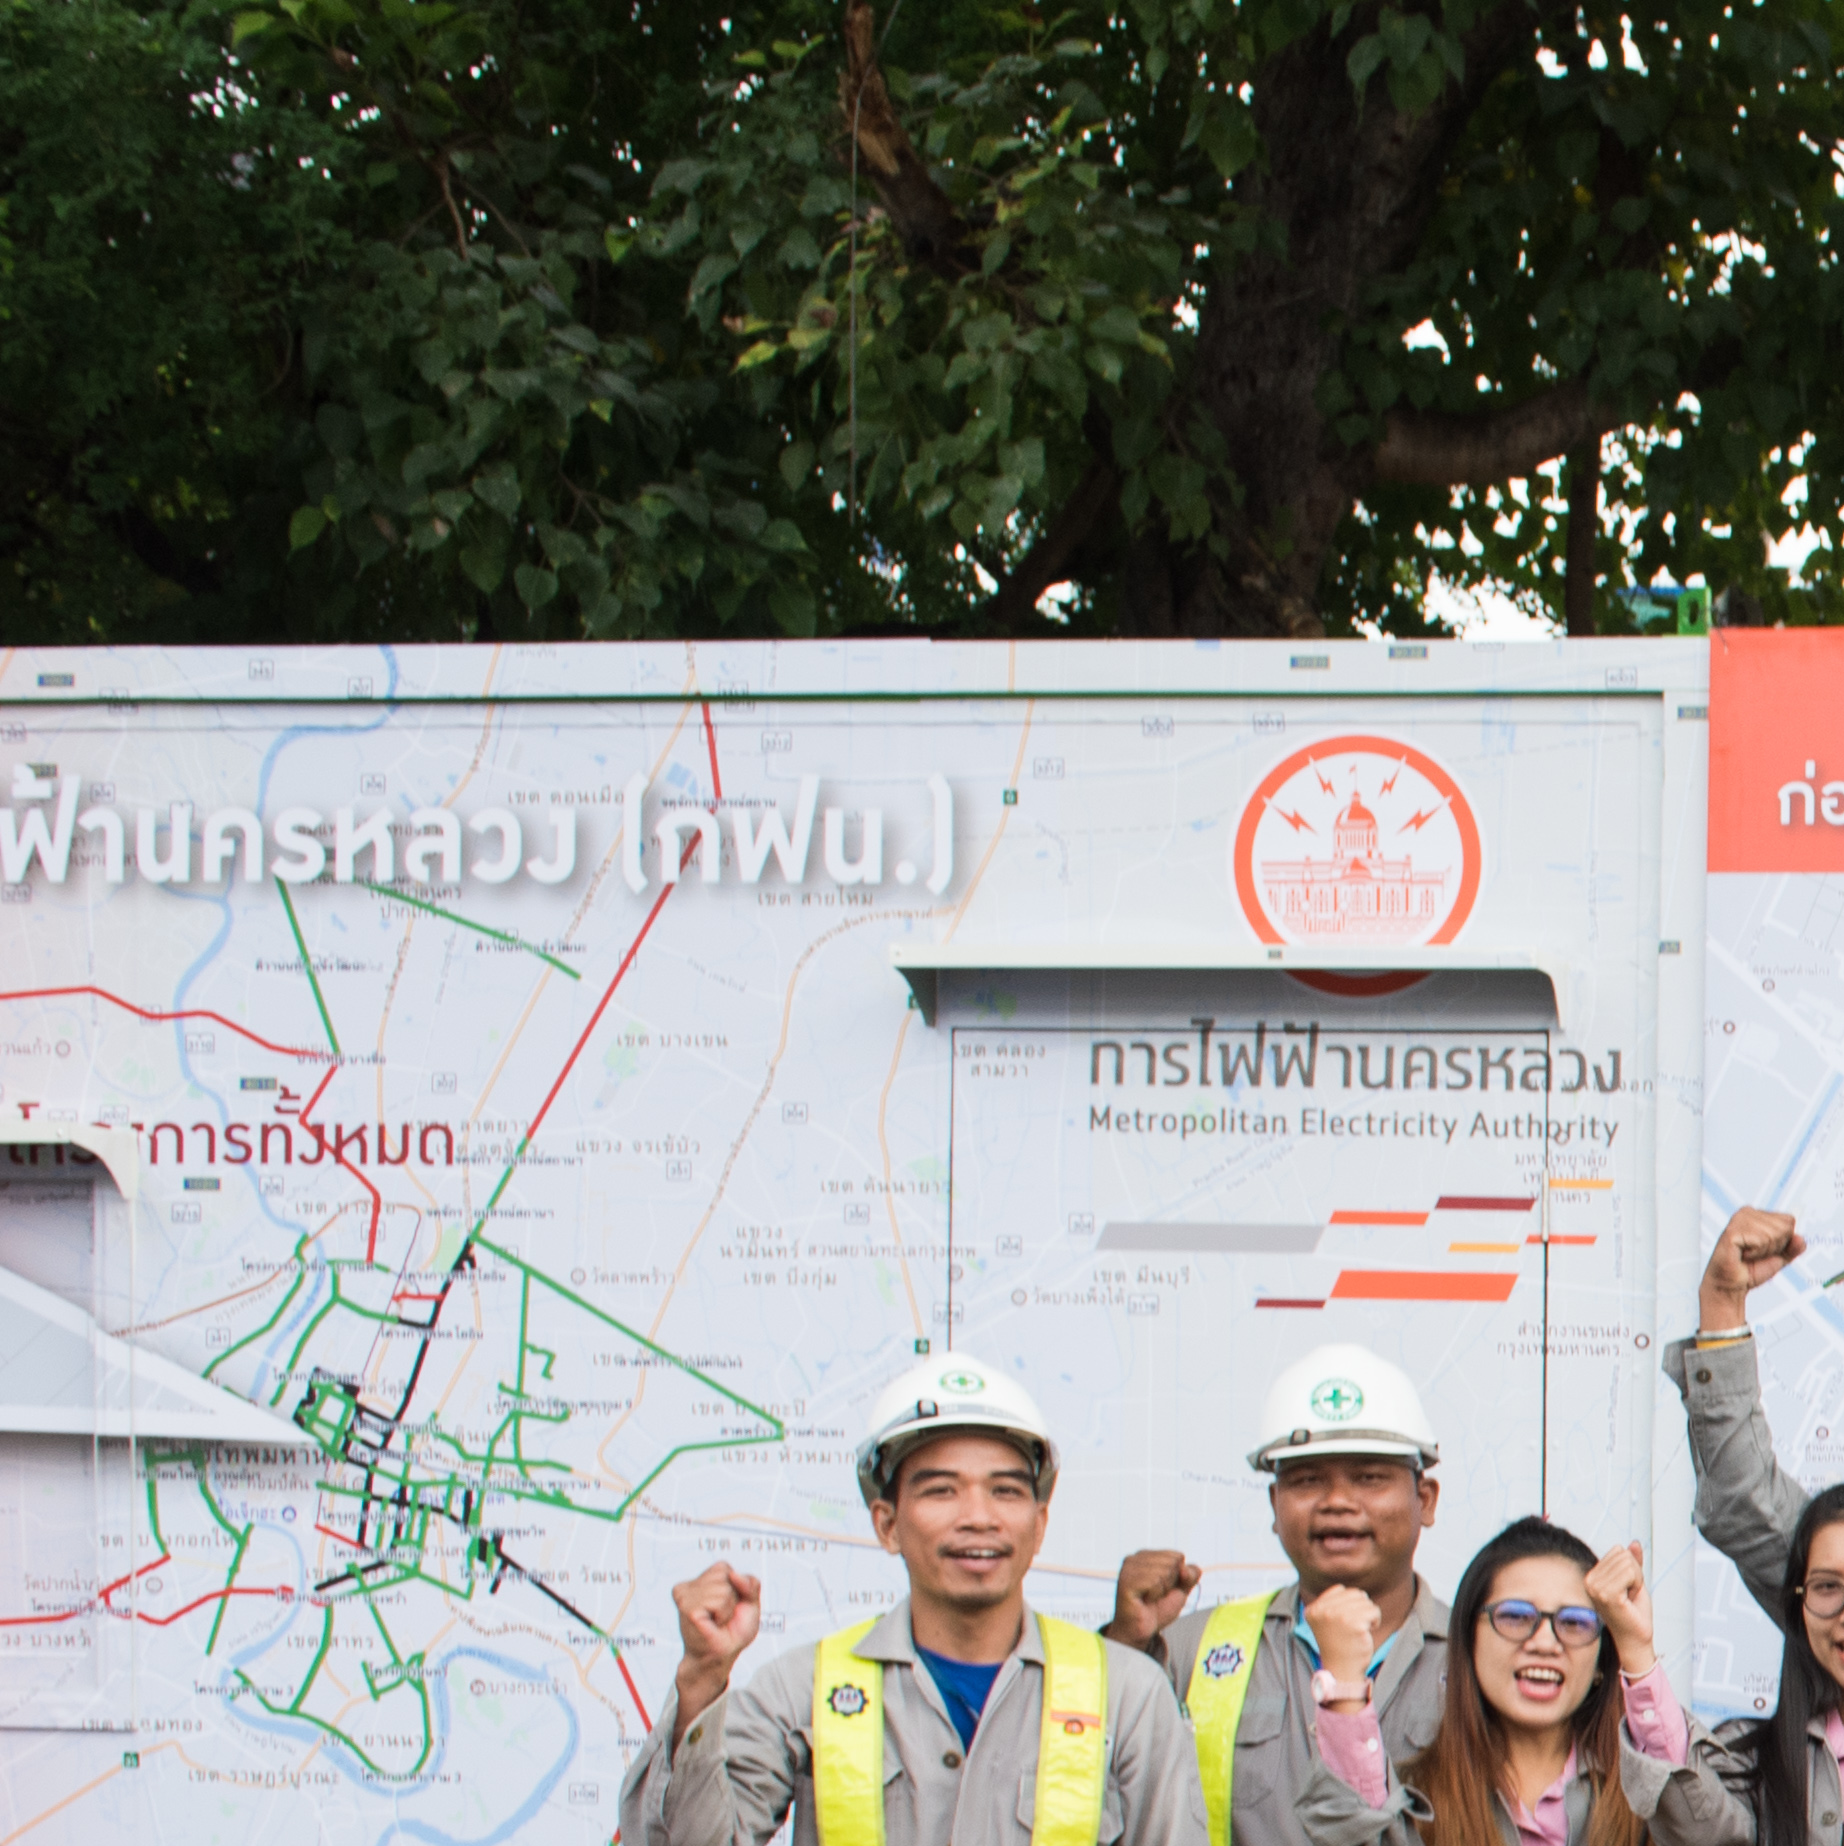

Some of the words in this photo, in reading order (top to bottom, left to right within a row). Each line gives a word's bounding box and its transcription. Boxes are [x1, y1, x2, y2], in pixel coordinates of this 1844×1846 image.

[551, 785, 625, 805] ดอนเมือ
[1089, 1020, 1624, 1095] การไฟฟ้านครหลวง
[1088, 1104, 1287, 1142] Metropolitan
[1301, 1106, 1458, 1144] Electricity
[1468, 1111, 1621, 1147] Authority
